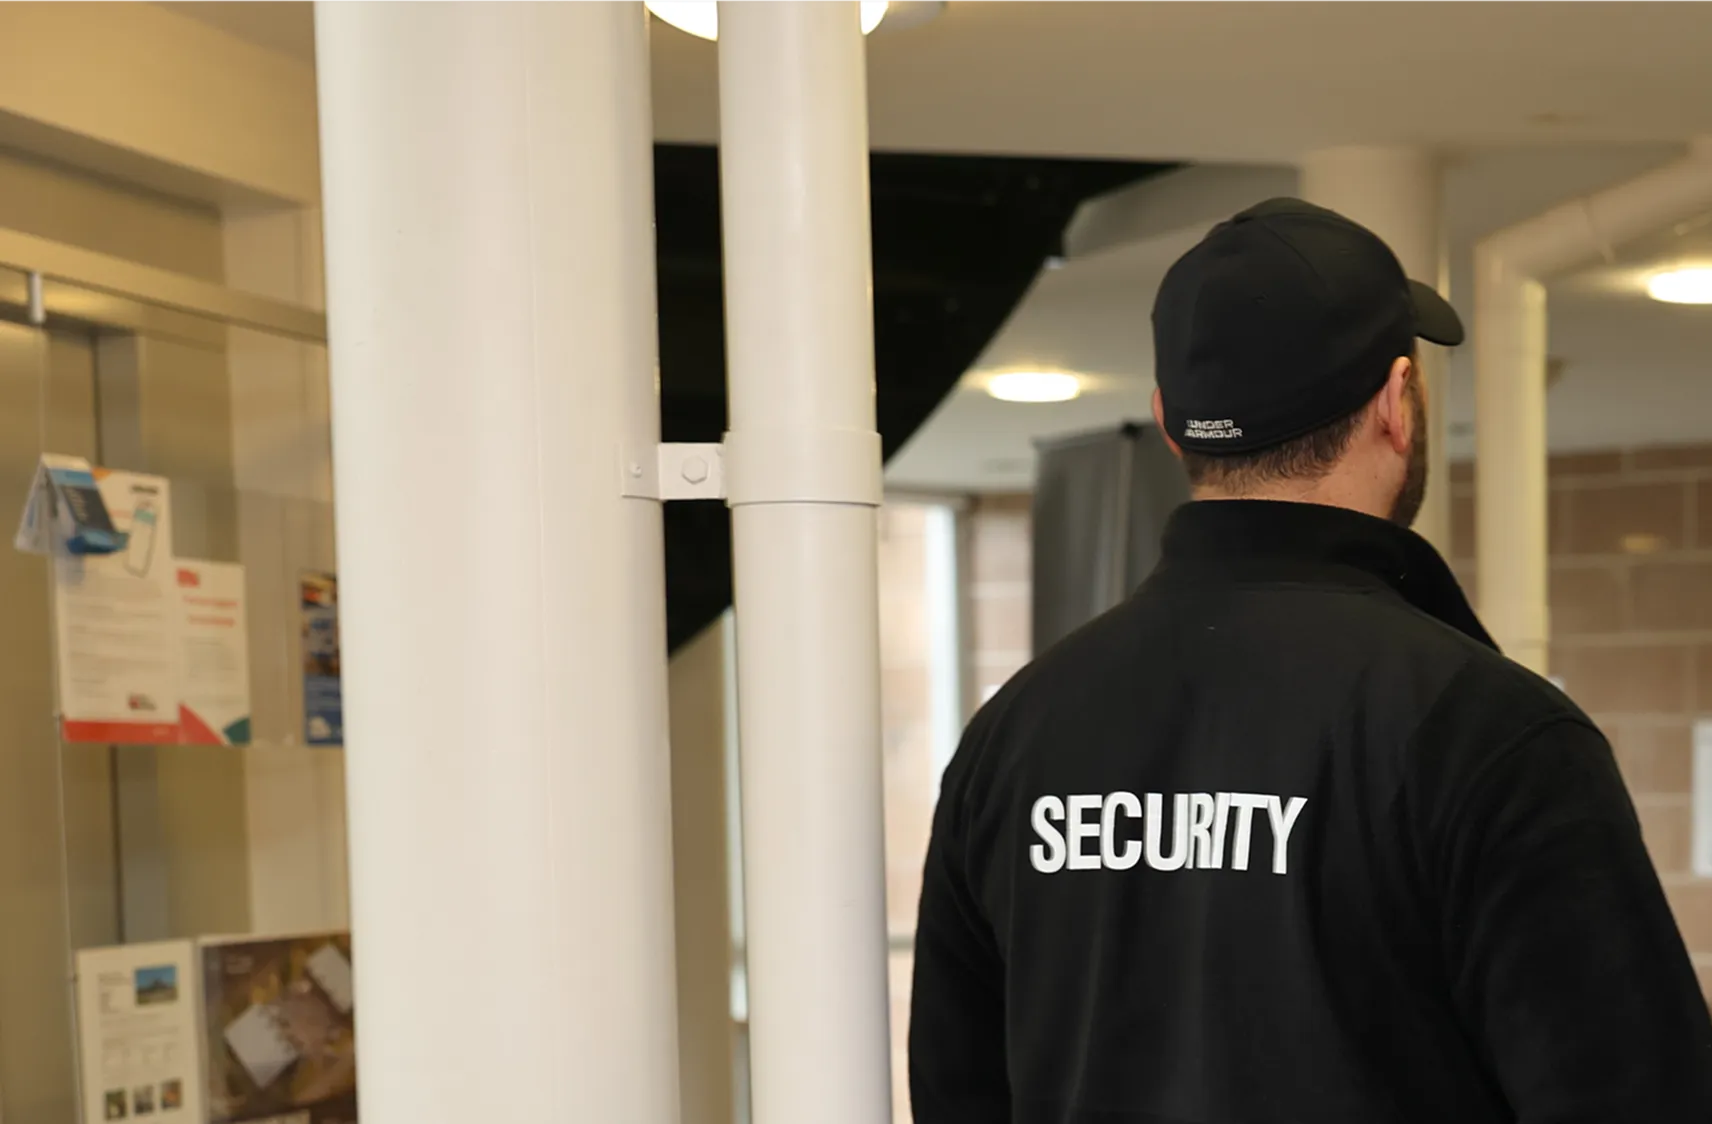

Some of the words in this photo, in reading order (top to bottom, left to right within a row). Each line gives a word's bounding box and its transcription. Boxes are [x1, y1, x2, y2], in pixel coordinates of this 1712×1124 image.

[1187, 419, 1234, 429] UNDER
[1184, 428, 1243, 439] ARMOUR
[1028, 790, 1308, 875] SECURITY
